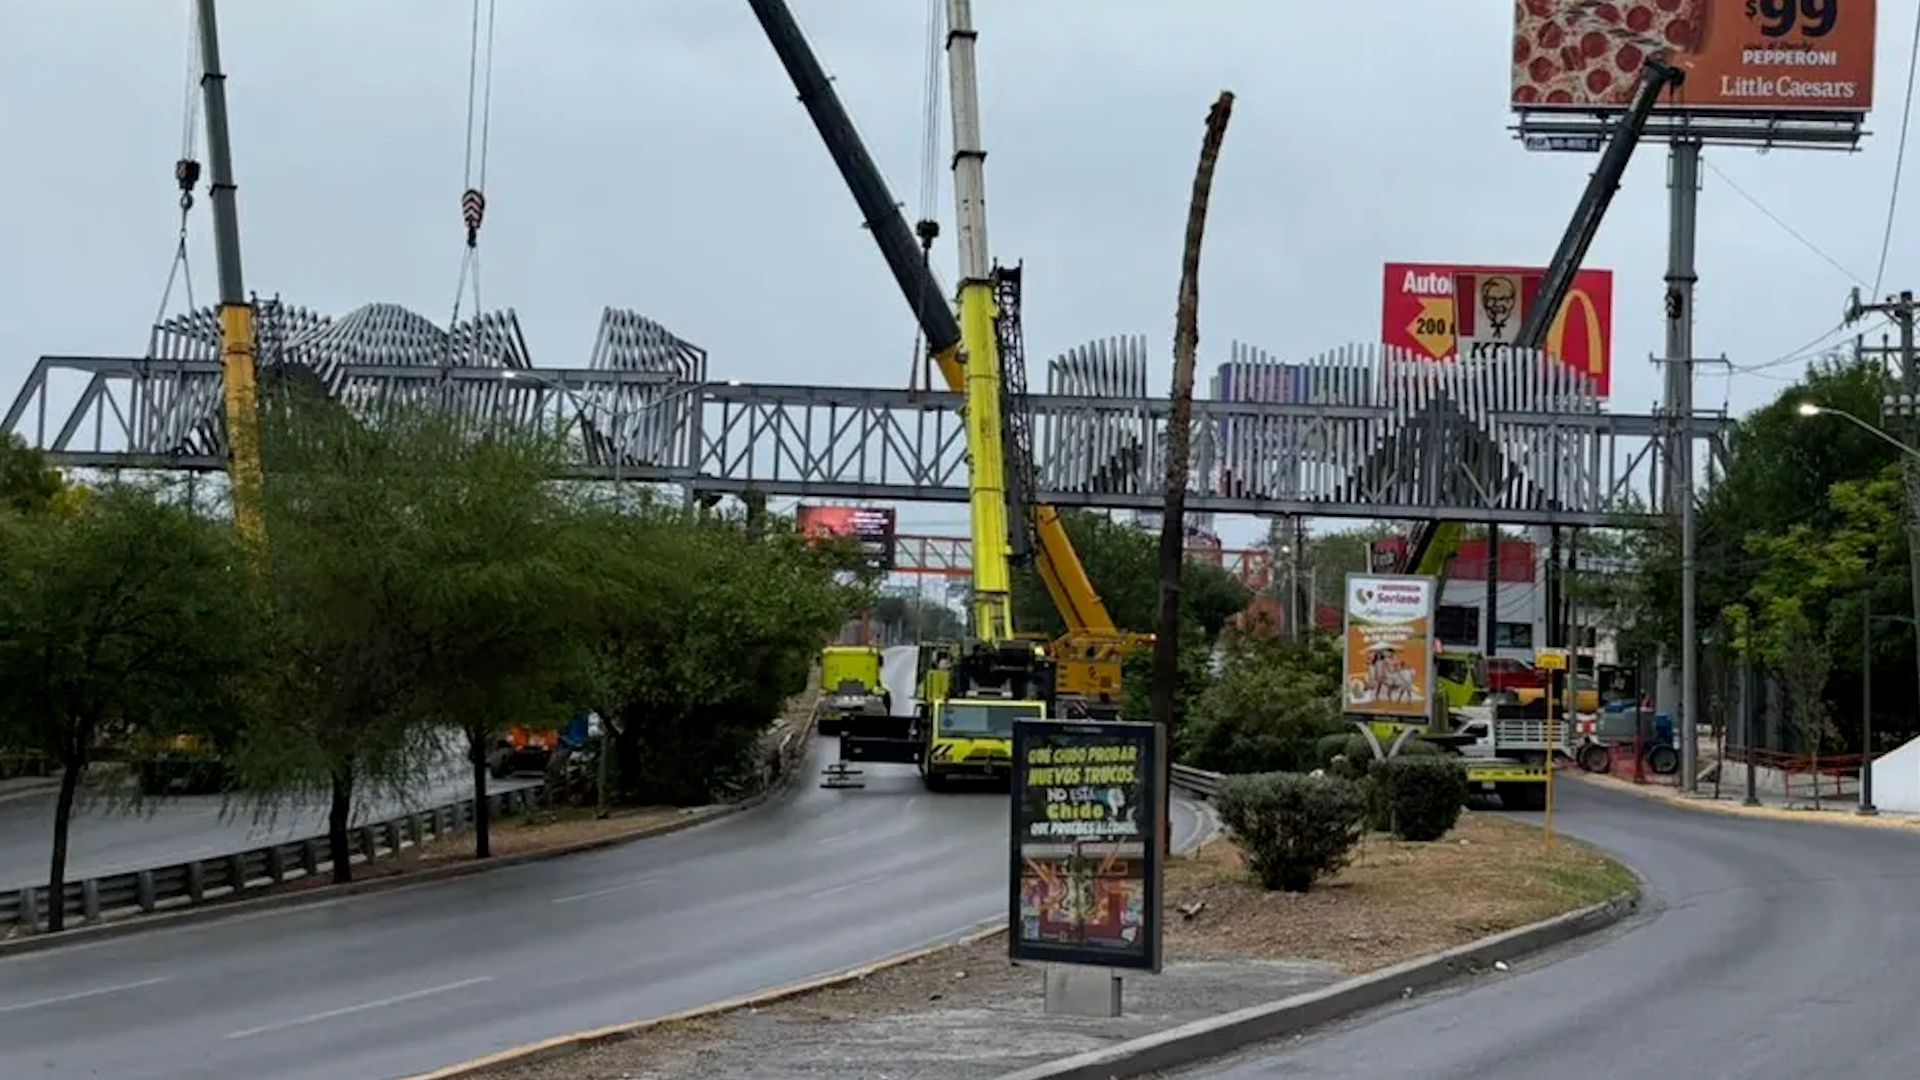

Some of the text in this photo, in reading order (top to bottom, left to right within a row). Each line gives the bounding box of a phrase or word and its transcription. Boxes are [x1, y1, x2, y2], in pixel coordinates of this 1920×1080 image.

[1742, 49, 1837, 66] PEPPERONI
[1721, 76, 1855, 98] Little Caesars
[1416, 317, 1446, 336] 200
[1377, 593, 1420, 605] Soriana
[1087, 745, 1137, 763] PROBAR
[1028, 766, 1081, 786] NUEVOS
[1046, 787, 1068, 802] NO
[1046, 801, 1104, 820] Chido
